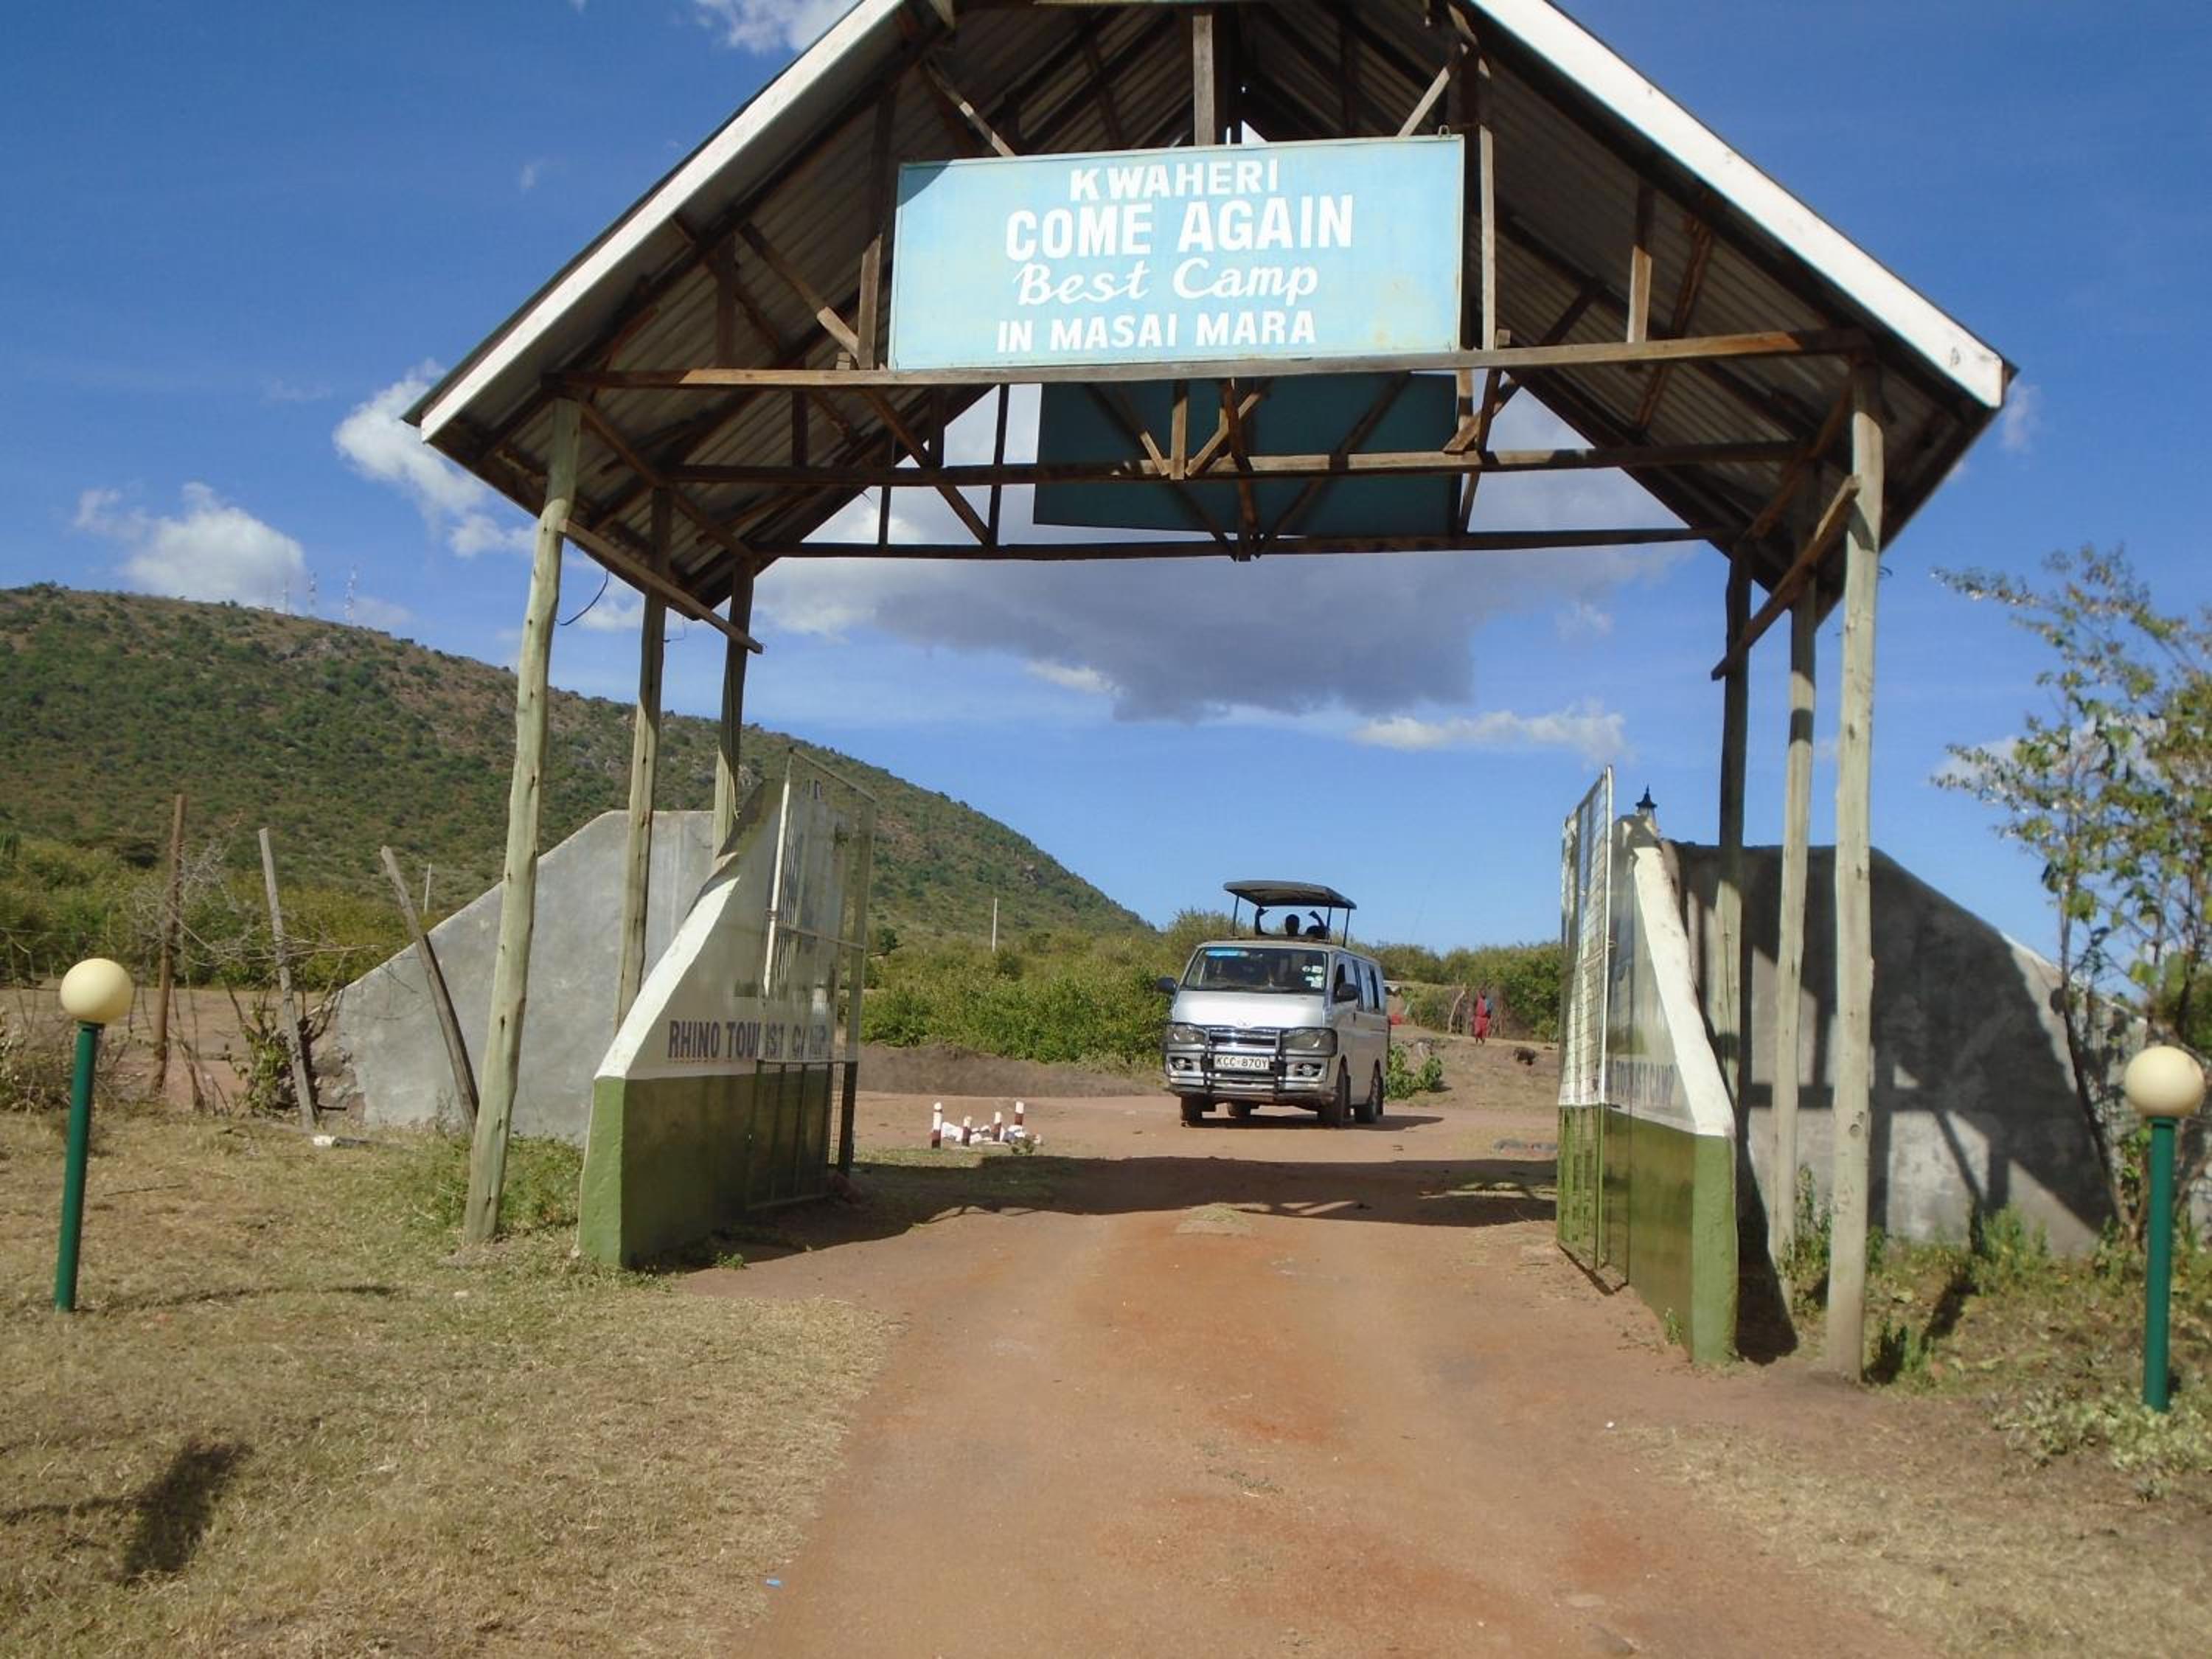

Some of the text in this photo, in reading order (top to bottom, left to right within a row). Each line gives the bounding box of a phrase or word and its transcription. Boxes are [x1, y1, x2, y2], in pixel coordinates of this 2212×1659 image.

[1071, 159, 1278, 201] KWAHERI
[1006, 195, 1354, 261] COME AGAIN
[1012, 257, 1318, 307] Best Camp
[997, 310, 1316, 352] IN MASAI MARA
[668, 1020, 720, 1059] RHINO
